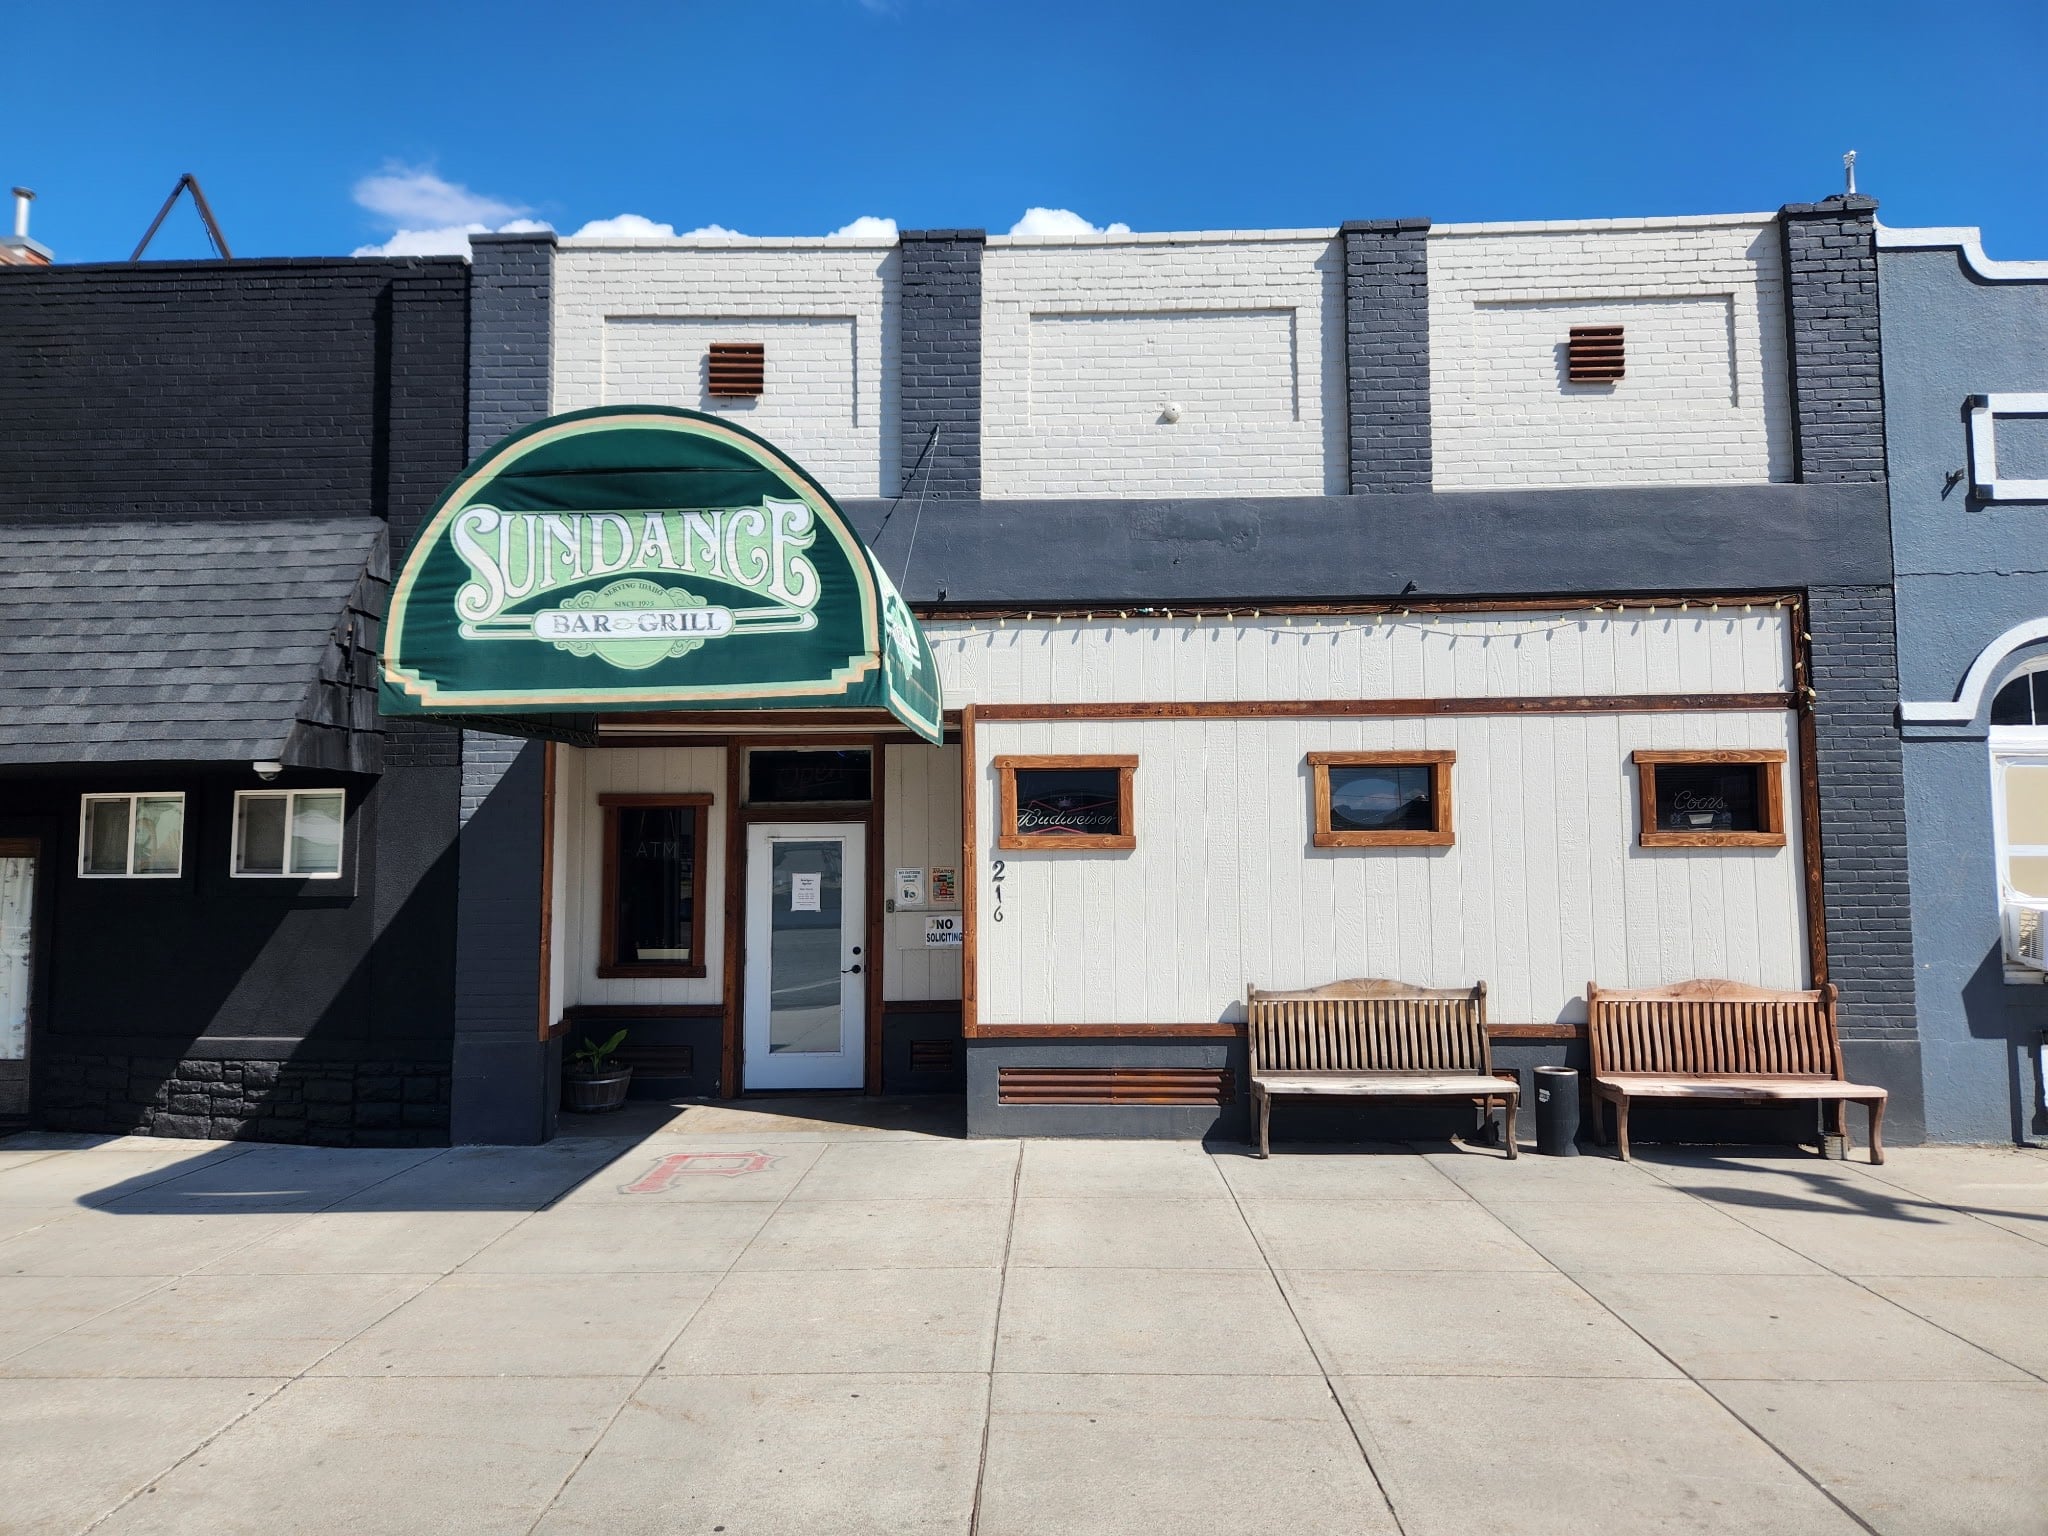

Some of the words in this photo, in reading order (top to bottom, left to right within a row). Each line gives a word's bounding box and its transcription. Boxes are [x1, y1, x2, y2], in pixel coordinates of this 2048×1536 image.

[454, 500, 817, 621] SUNDANCE
[604, 583, 636, 597] SERVING
[639, 583, 664, 596] IDAHO
[552, 614, 611, 634] BAR
[637, 612, 721, 632] GRILL
[1674, 790, 1724, 809] Coors
[1017, 808, 1115, 827] Budweiser
[636, 841, 679, 857] ATM
[936, 919, 953, 929] NO
[926, 932, 963, 943] SOLICITING
